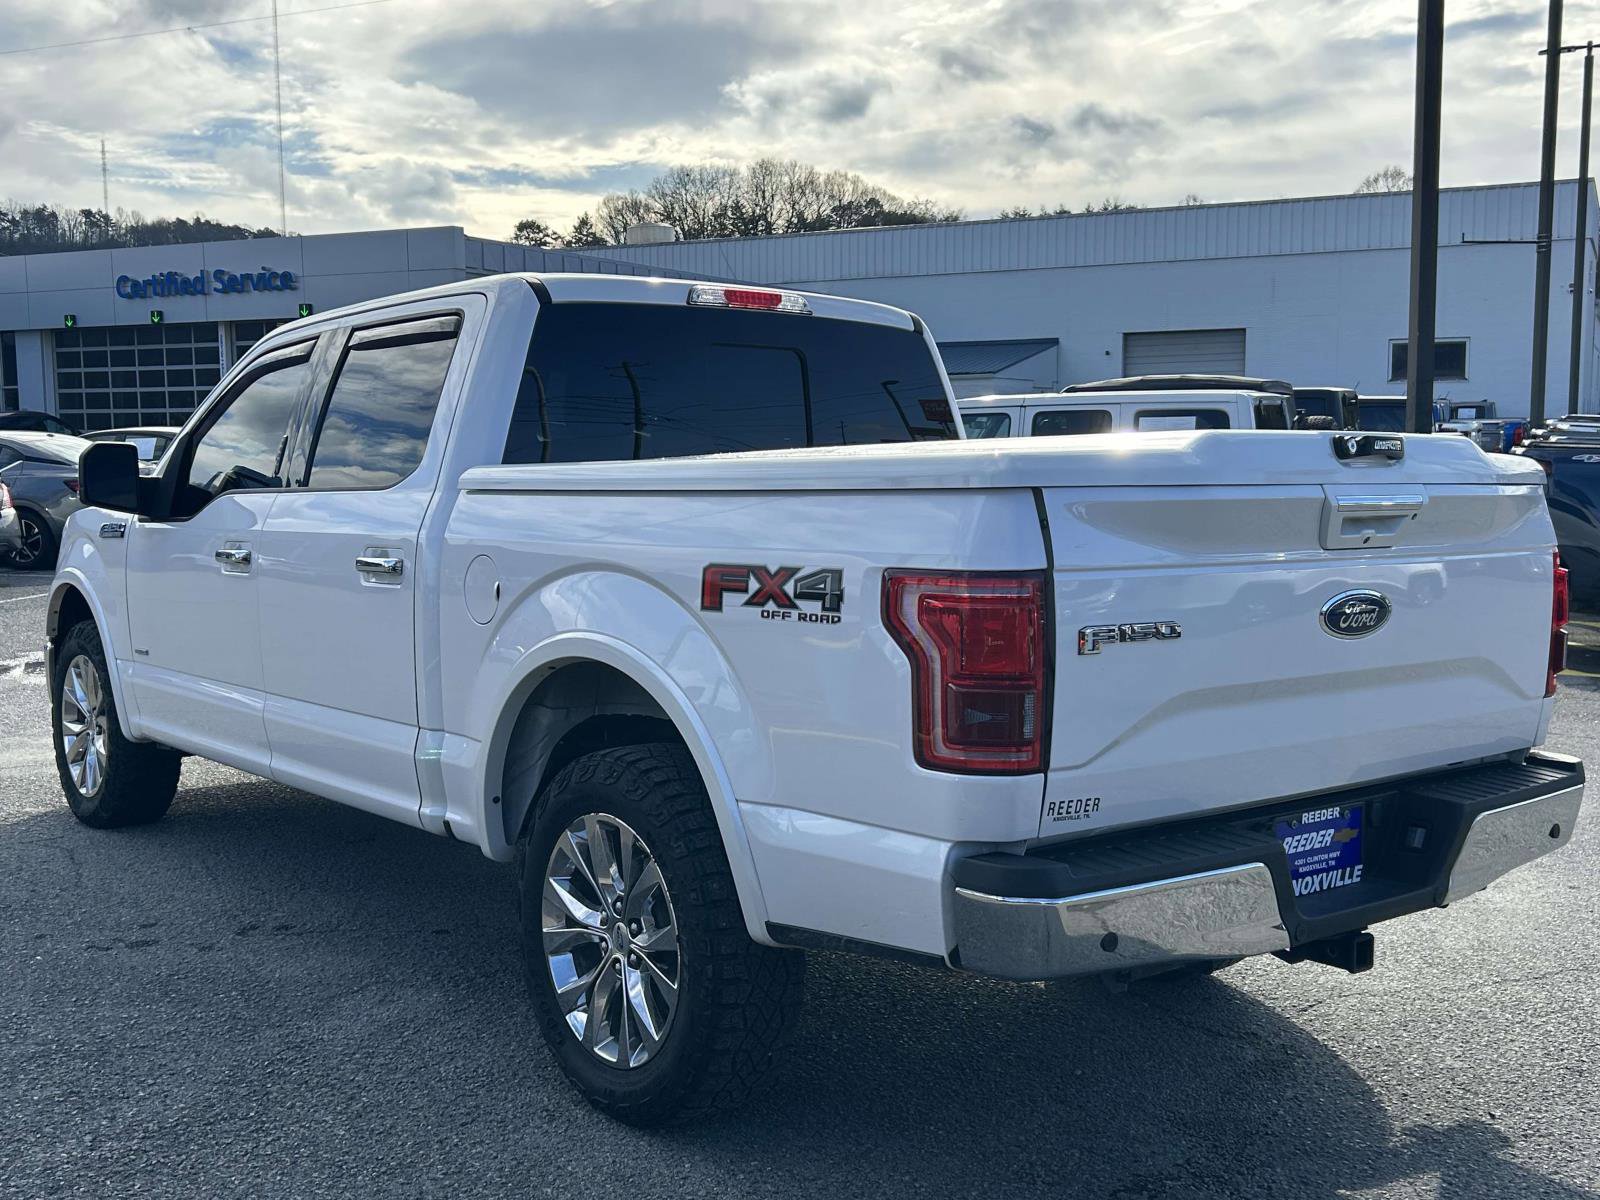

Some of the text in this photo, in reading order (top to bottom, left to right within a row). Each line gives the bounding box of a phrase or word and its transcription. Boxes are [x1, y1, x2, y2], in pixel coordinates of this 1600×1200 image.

[115, 266, 298, 299] Certified Service
[701, 563, 844, 613] FX4
[761, 609, 842, 624] OFF ROAD
[1339, 600, 1380, 629] Ford
[1047, 797, 1100, 816] REEDER
[1302, 806, 1340, 824] REEDER
[1306, 853, 1329, 863] CLINTON
[1328, 850, 1341, 859] HWY
[1292, 864, 1364, 897] NOXVILLE
